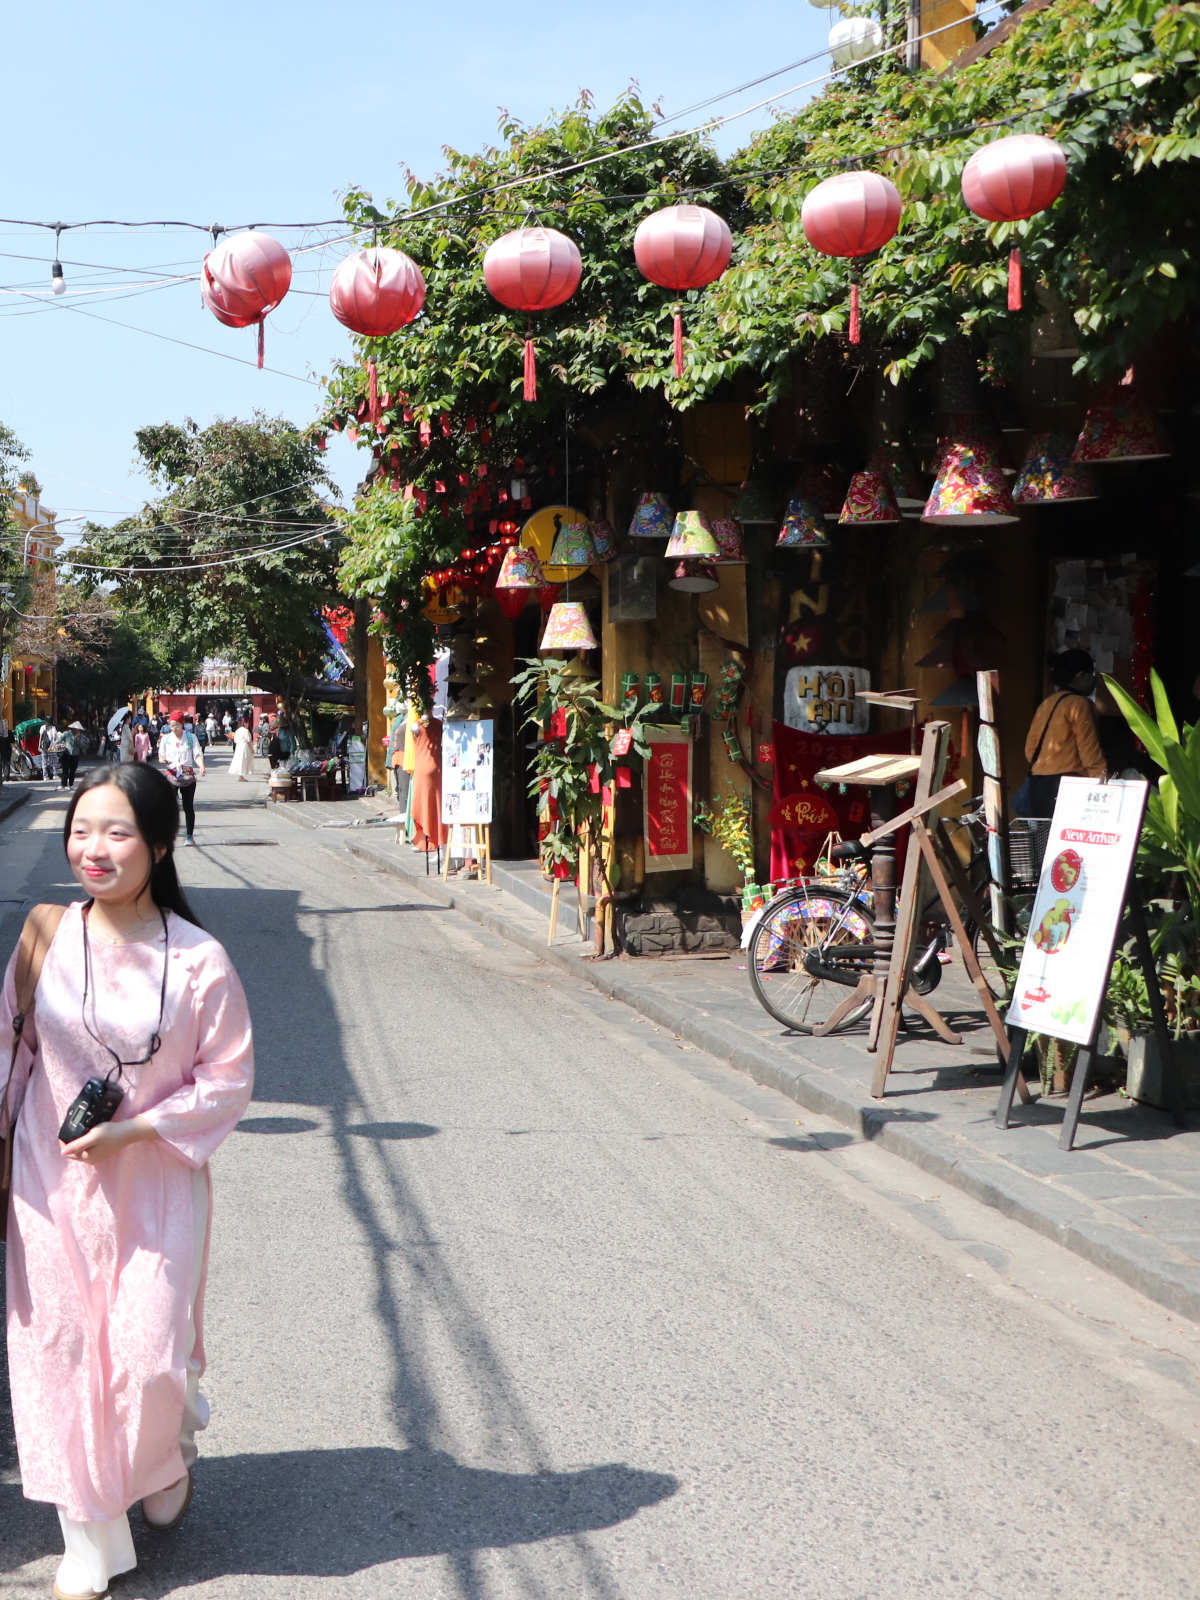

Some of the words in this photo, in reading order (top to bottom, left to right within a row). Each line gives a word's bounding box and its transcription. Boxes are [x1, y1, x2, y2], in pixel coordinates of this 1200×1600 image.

[796, 741, 853, 760] 2025
[1064, 829, 1086, 841] New
[1085, 831, 1119, 845] Arrival
